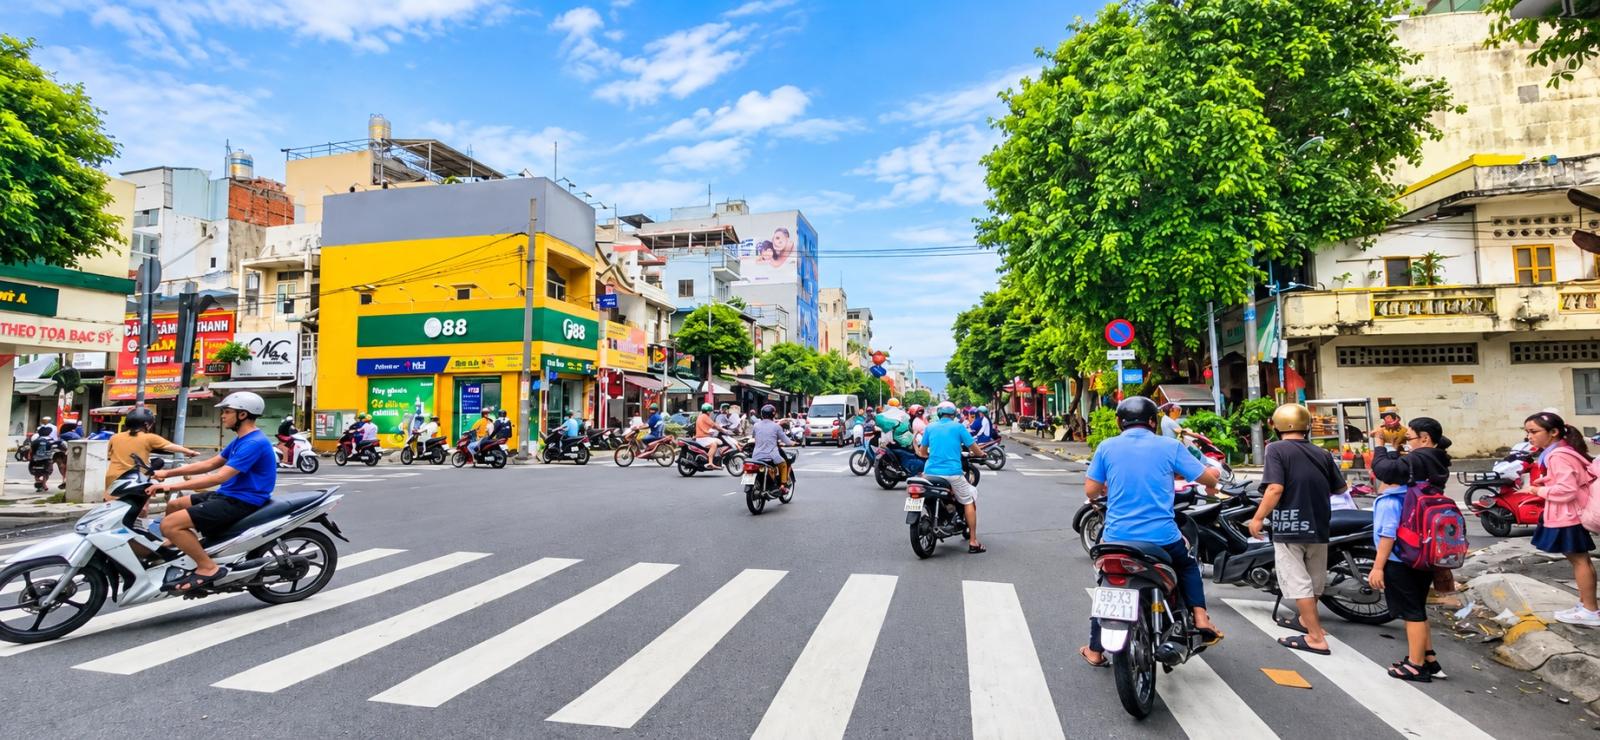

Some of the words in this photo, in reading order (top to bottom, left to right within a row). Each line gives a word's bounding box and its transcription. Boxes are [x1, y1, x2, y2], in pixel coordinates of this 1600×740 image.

[0, 323, 36, 337] THEO
[197, 320, 229, 333] THANH
[563, 318, 586, 340] F88
[1095, 603, 1133, 619] 472.11
